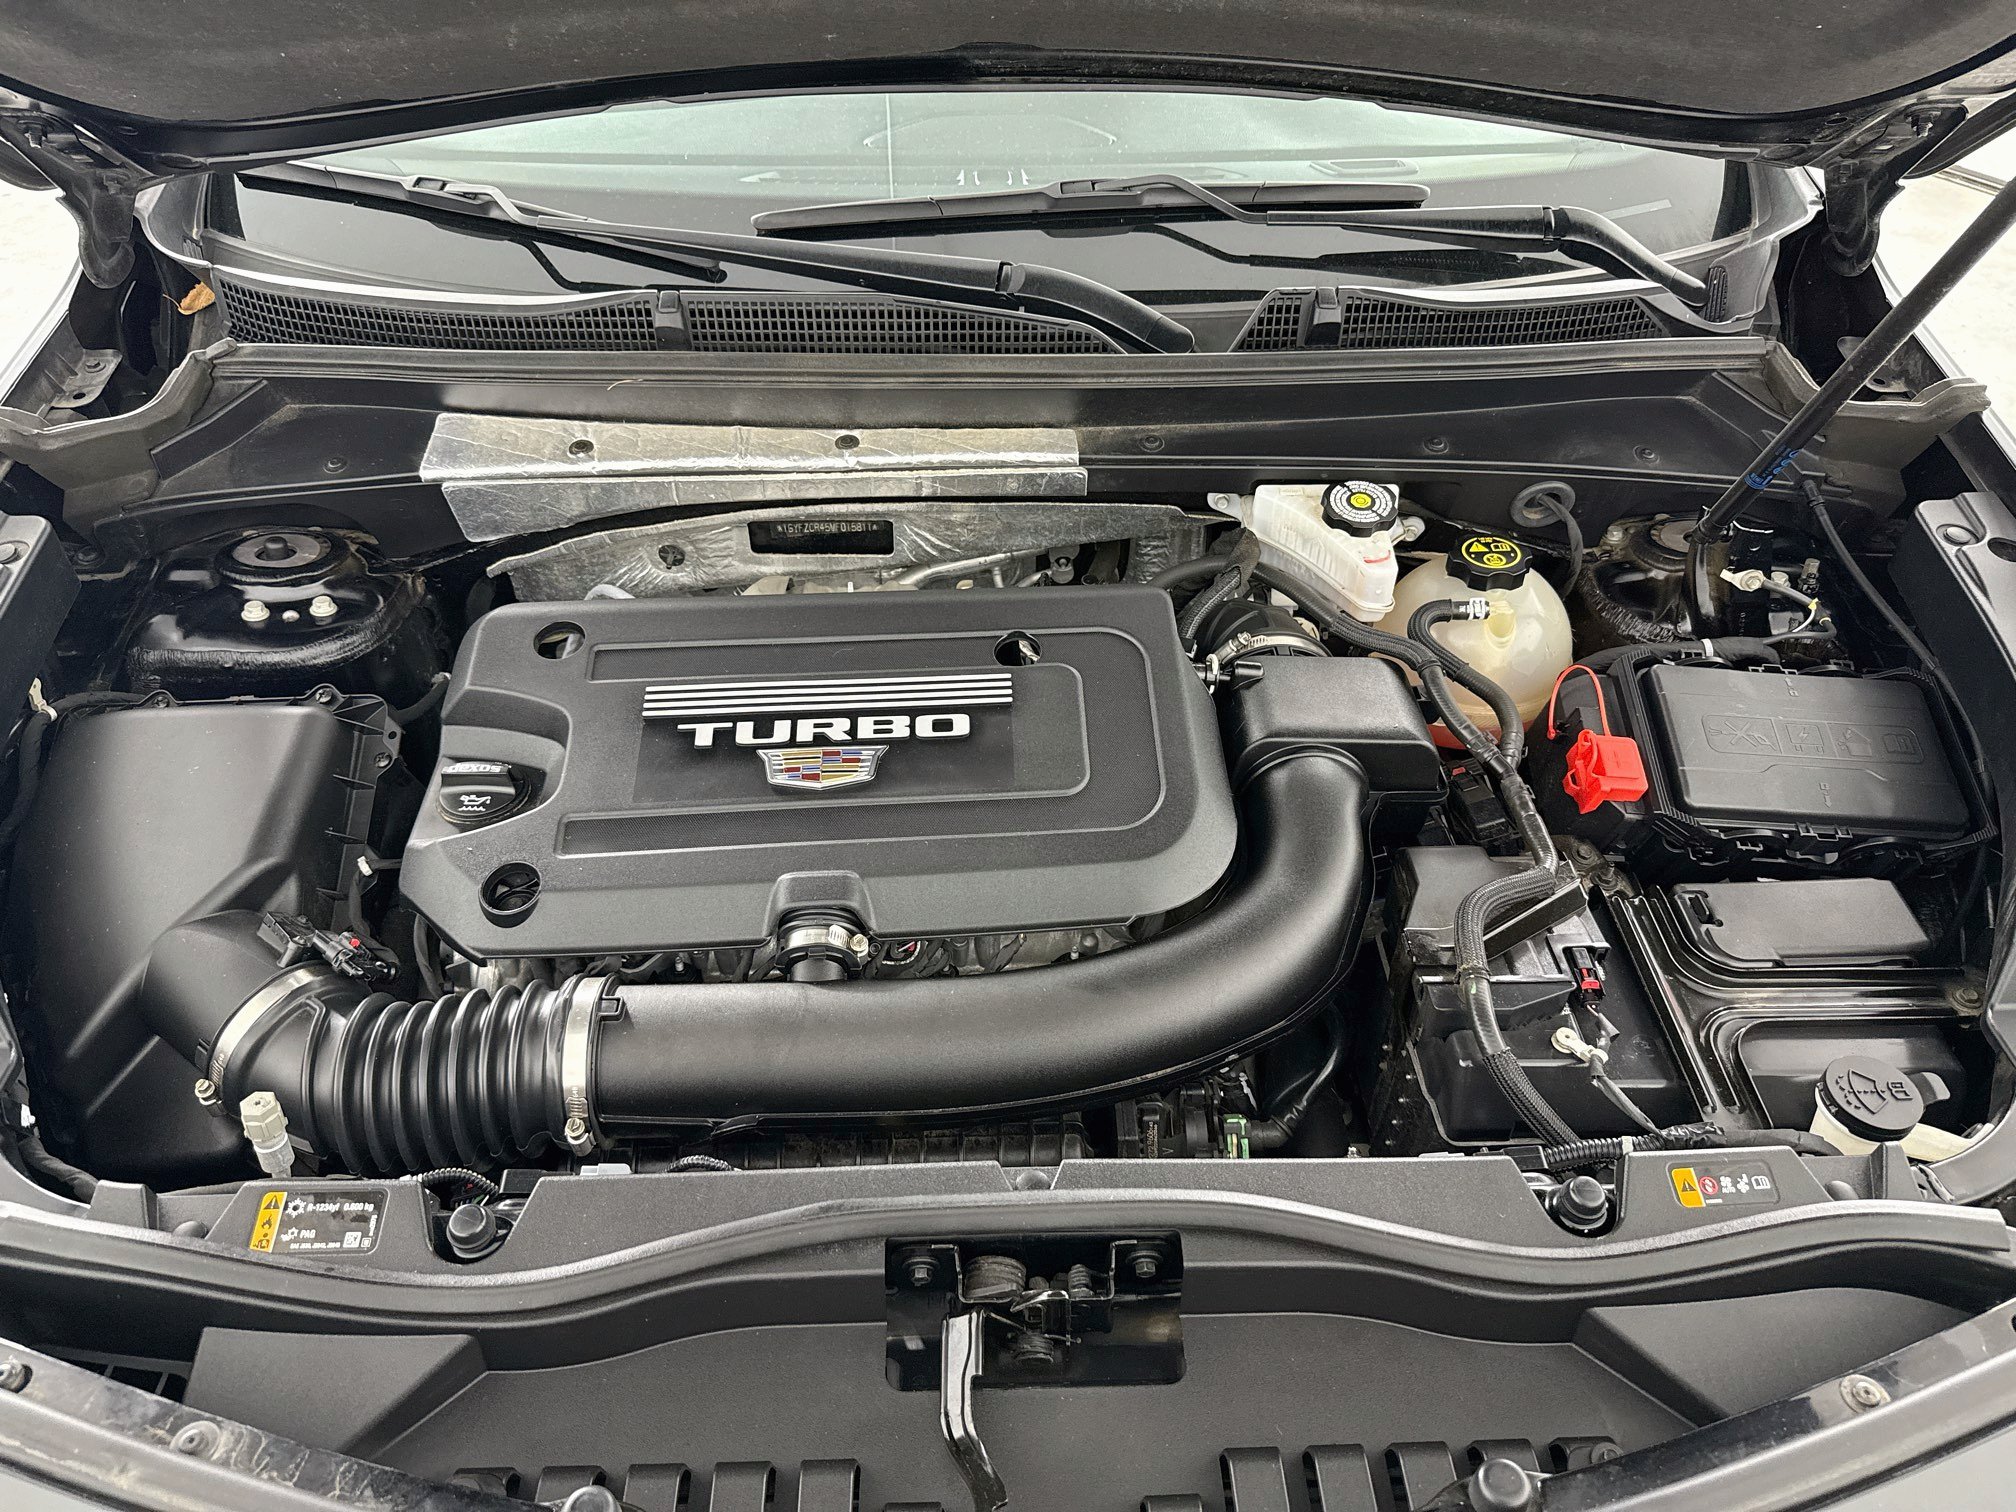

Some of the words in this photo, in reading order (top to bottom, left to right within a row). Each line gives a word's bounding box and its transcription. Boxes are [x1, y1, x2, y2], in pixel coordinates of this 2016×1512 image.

[677, 713, 971, 749] TURBO
[446, 763, 502, 773] dexos
[307, 1202, 340, 1213] R-1234yf
[364, 1202, 374, 1213] kg
